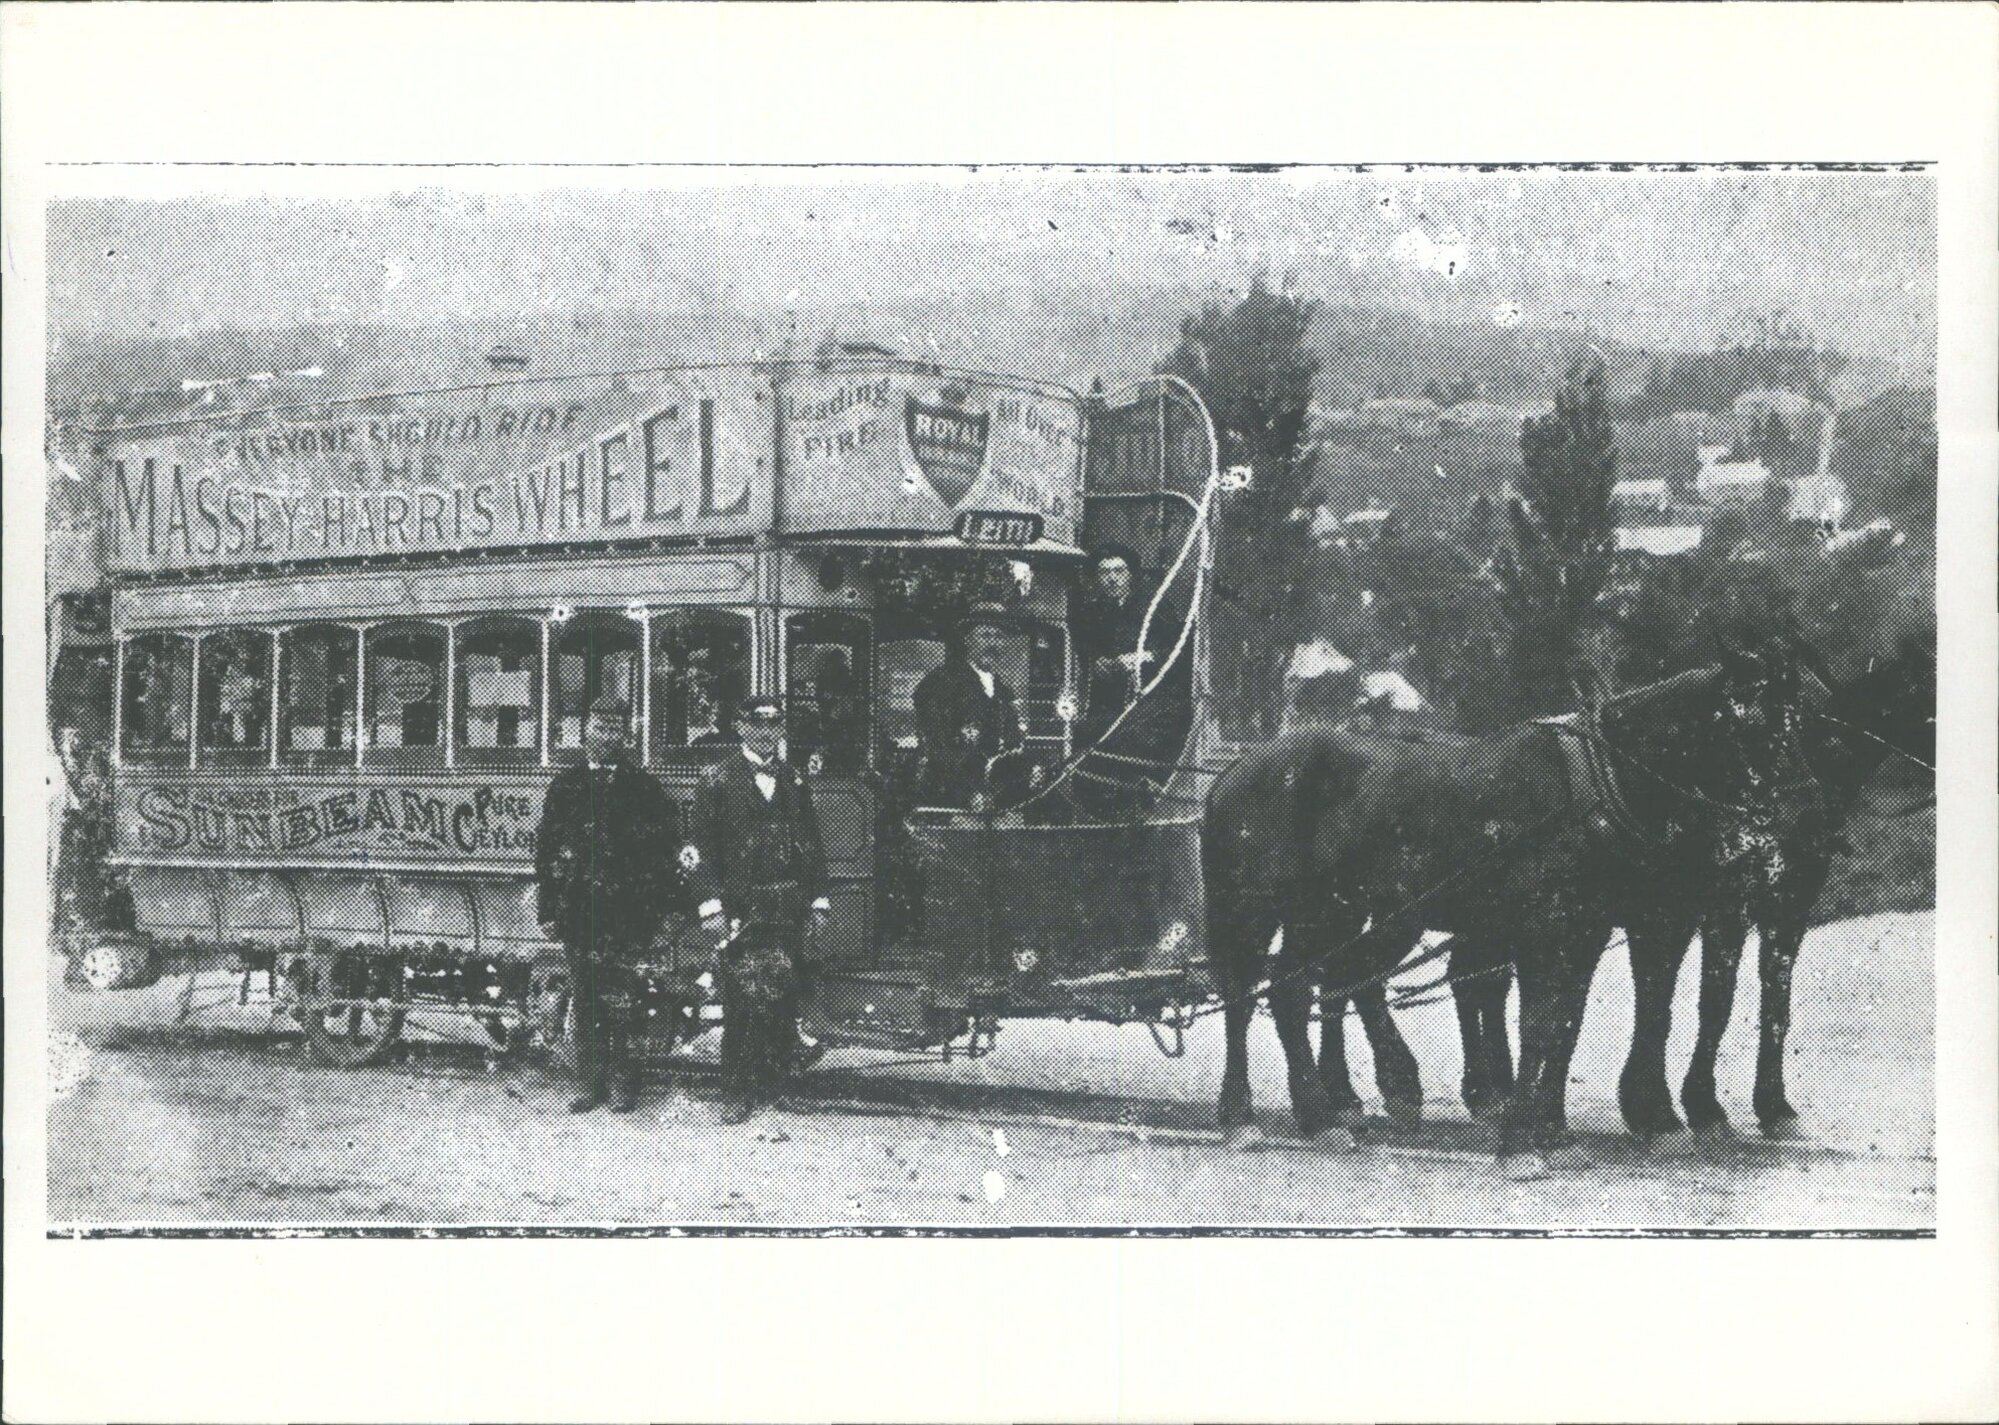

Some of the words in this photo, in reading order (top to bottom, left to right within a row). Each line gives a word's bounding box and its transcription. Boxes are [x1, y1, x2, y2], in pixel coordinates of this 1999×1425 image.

[495, 403, 585, 439] RIDE
[787, 377, 890, 421] Leading
[915, 413, 985, 446] ROYAL
[511, 398, 753, 532] WHEEL
[138, 785, 448, 851] SUNBEAM
